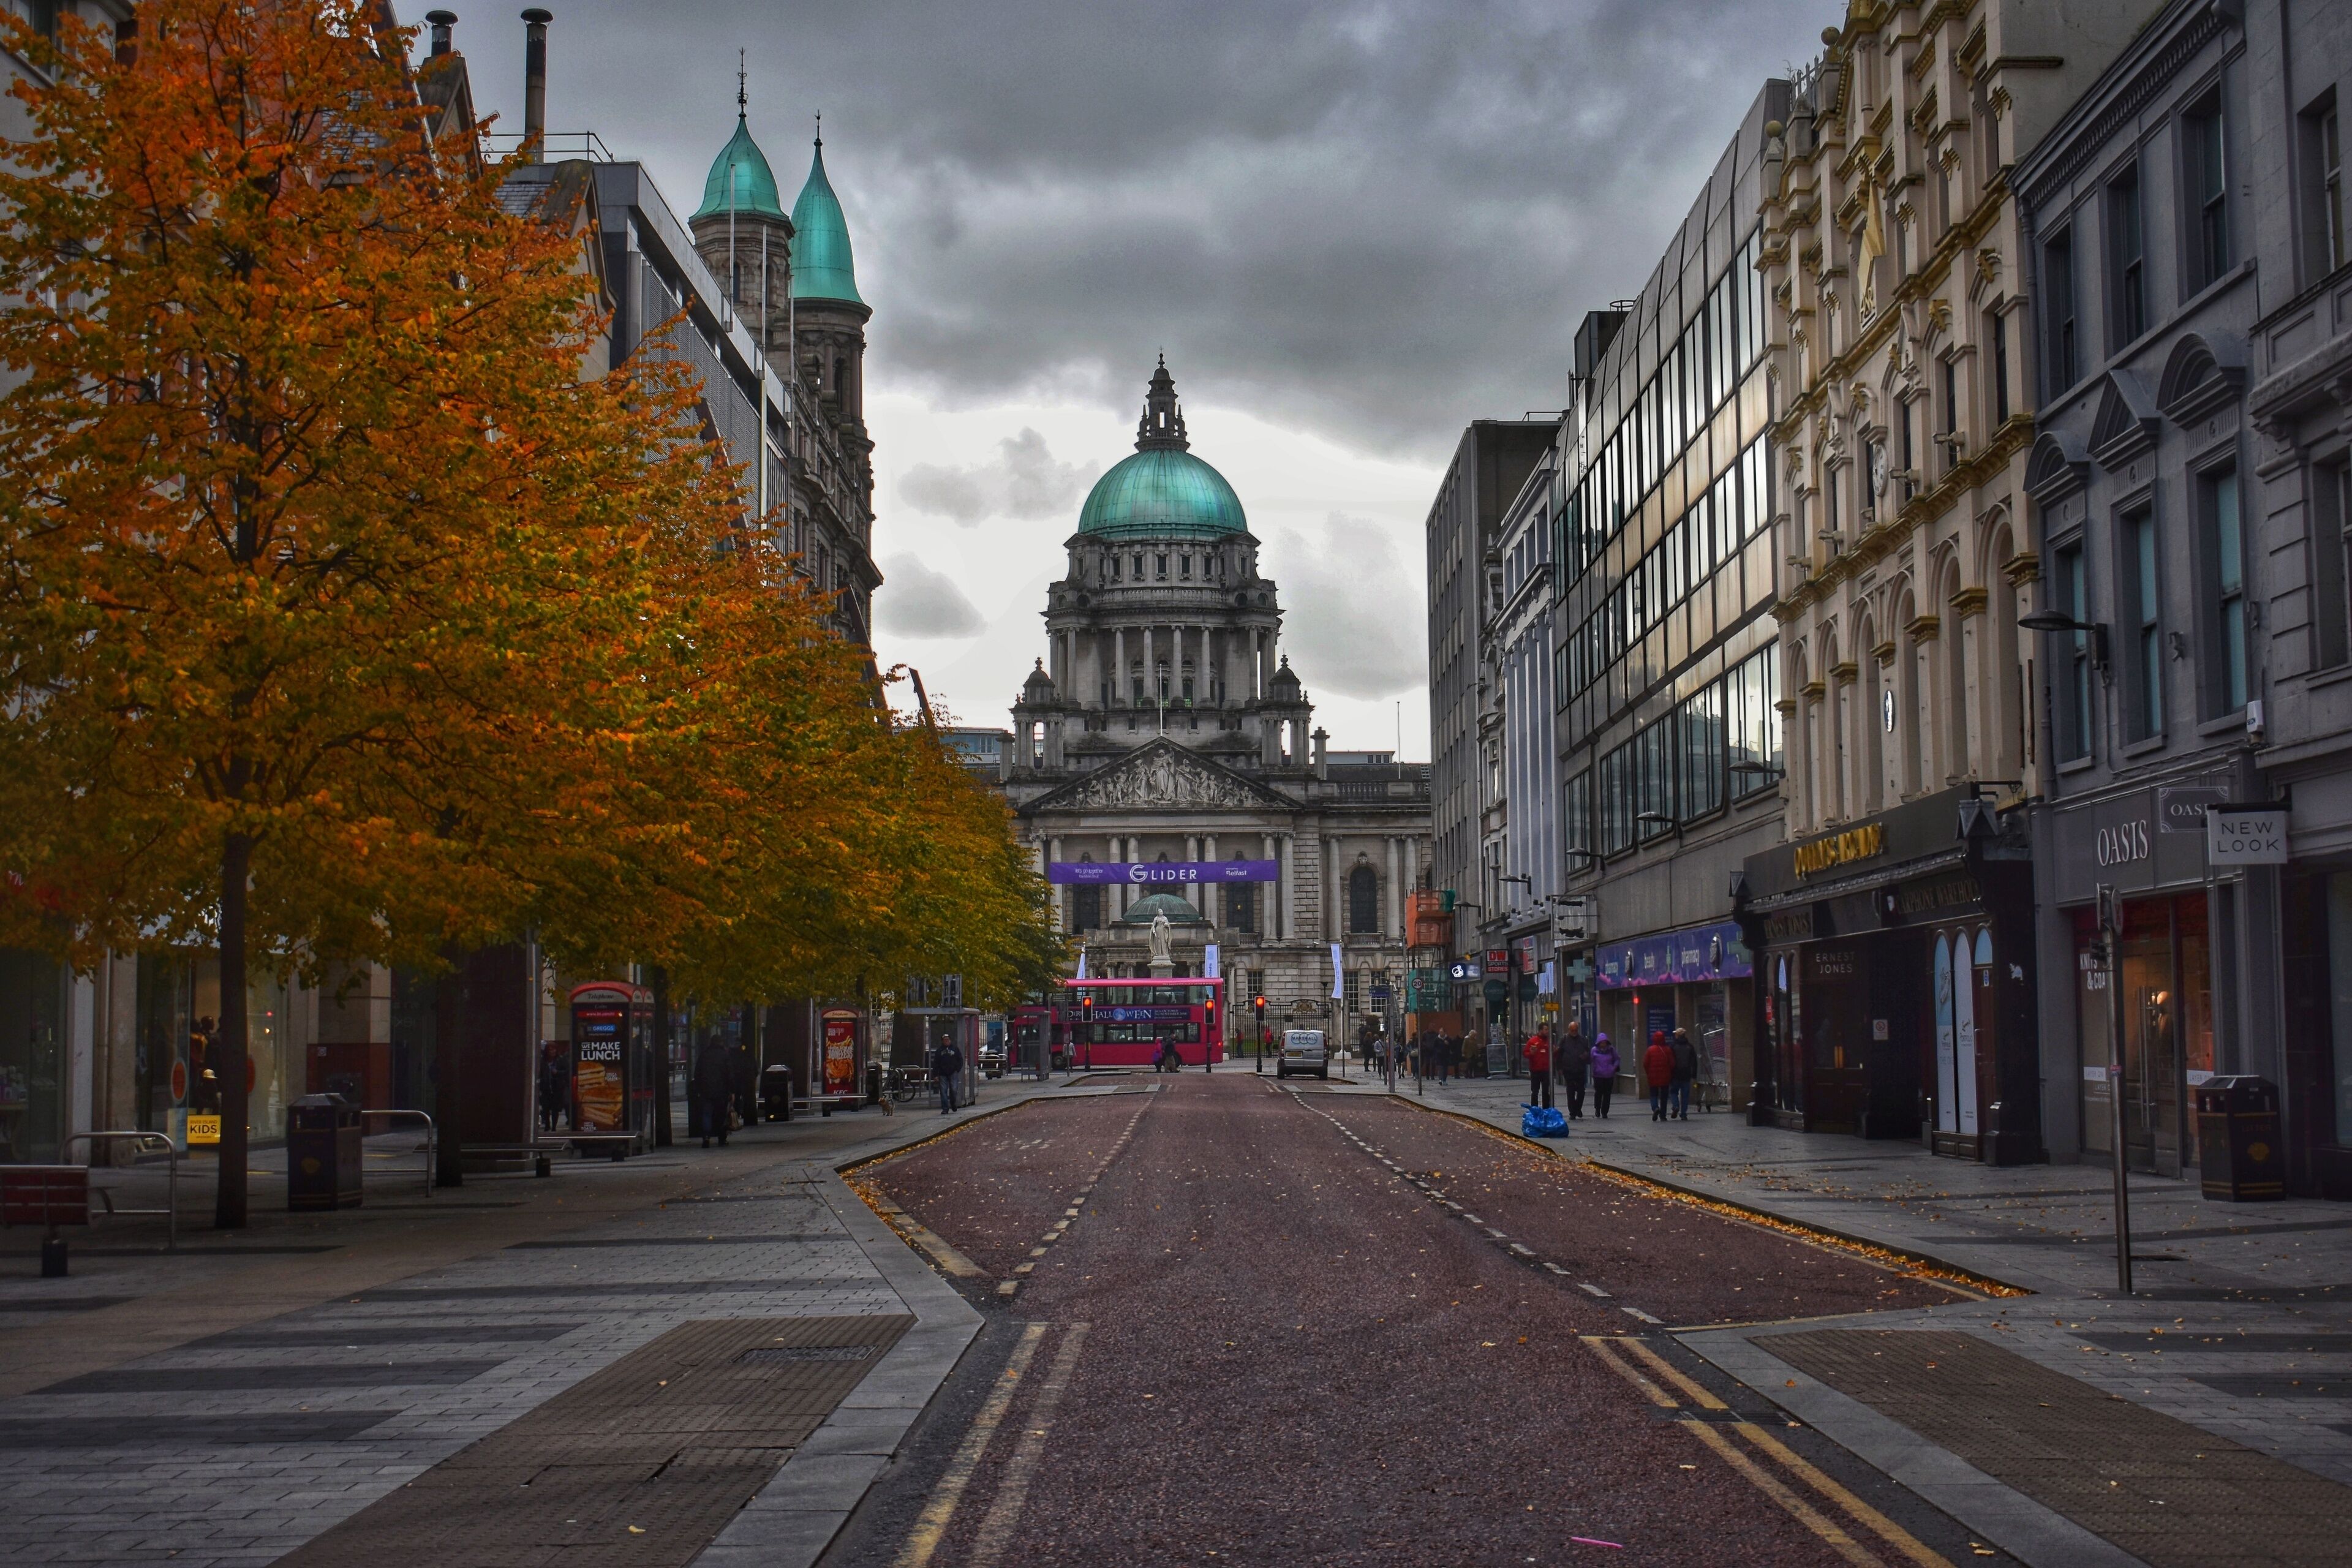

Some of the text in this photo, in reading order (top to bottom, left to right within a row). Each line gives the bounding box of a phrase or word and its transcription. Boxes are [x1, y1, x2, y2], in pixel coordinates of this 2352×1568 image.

[2170, 804, 2208, 816] OASI
[2222, 822, 2272, 834] NEW
[2098, 820, 2149, 867] OASIS
[2217, 839, 2279, 853] LOOK
[1129, 864, 1197, 883] GLIDER
[1489, 951, 1506, 960] DW
[1681, 947, 1700, 968] pharmacy
[1815, 951, 1856, 962] ERNEST
[1820, 963, 1853, 974] JONES
[2087, 971, 2094, 990] &
[591, 1042, 620, 1050] MAKE
[581, 1050, 620, 1060] LUNCH
[190, 1125, 217, 1134] KIDS
